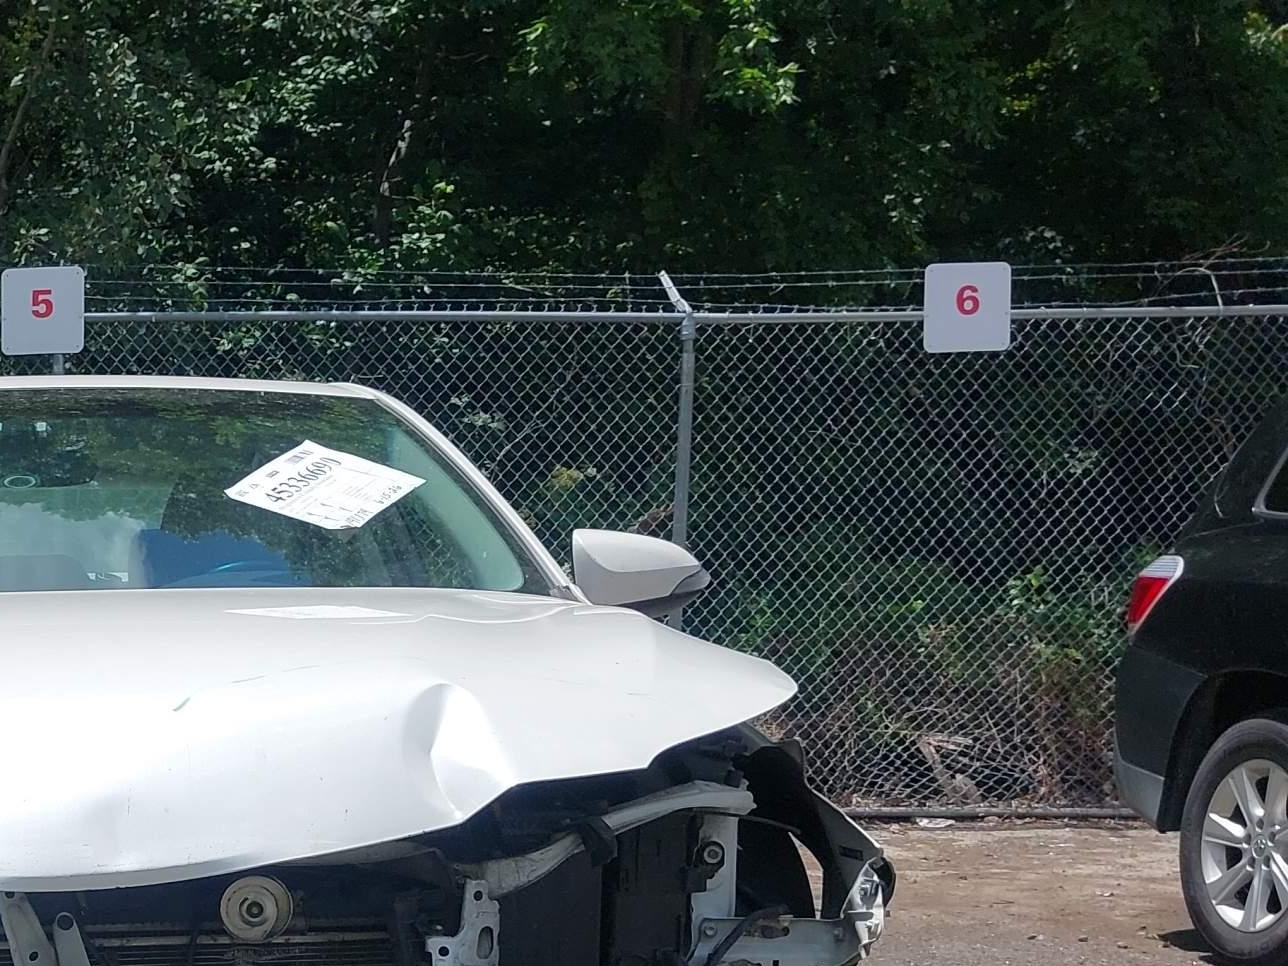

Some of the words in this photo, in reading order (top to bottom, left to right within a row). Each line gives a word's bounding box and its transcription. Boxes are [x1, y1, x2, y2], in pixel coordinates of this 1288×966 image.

[30, 288, 54, 318] 5
[955, 284, 981, 316] 6
[264, 456, 342, 503] 45336690
